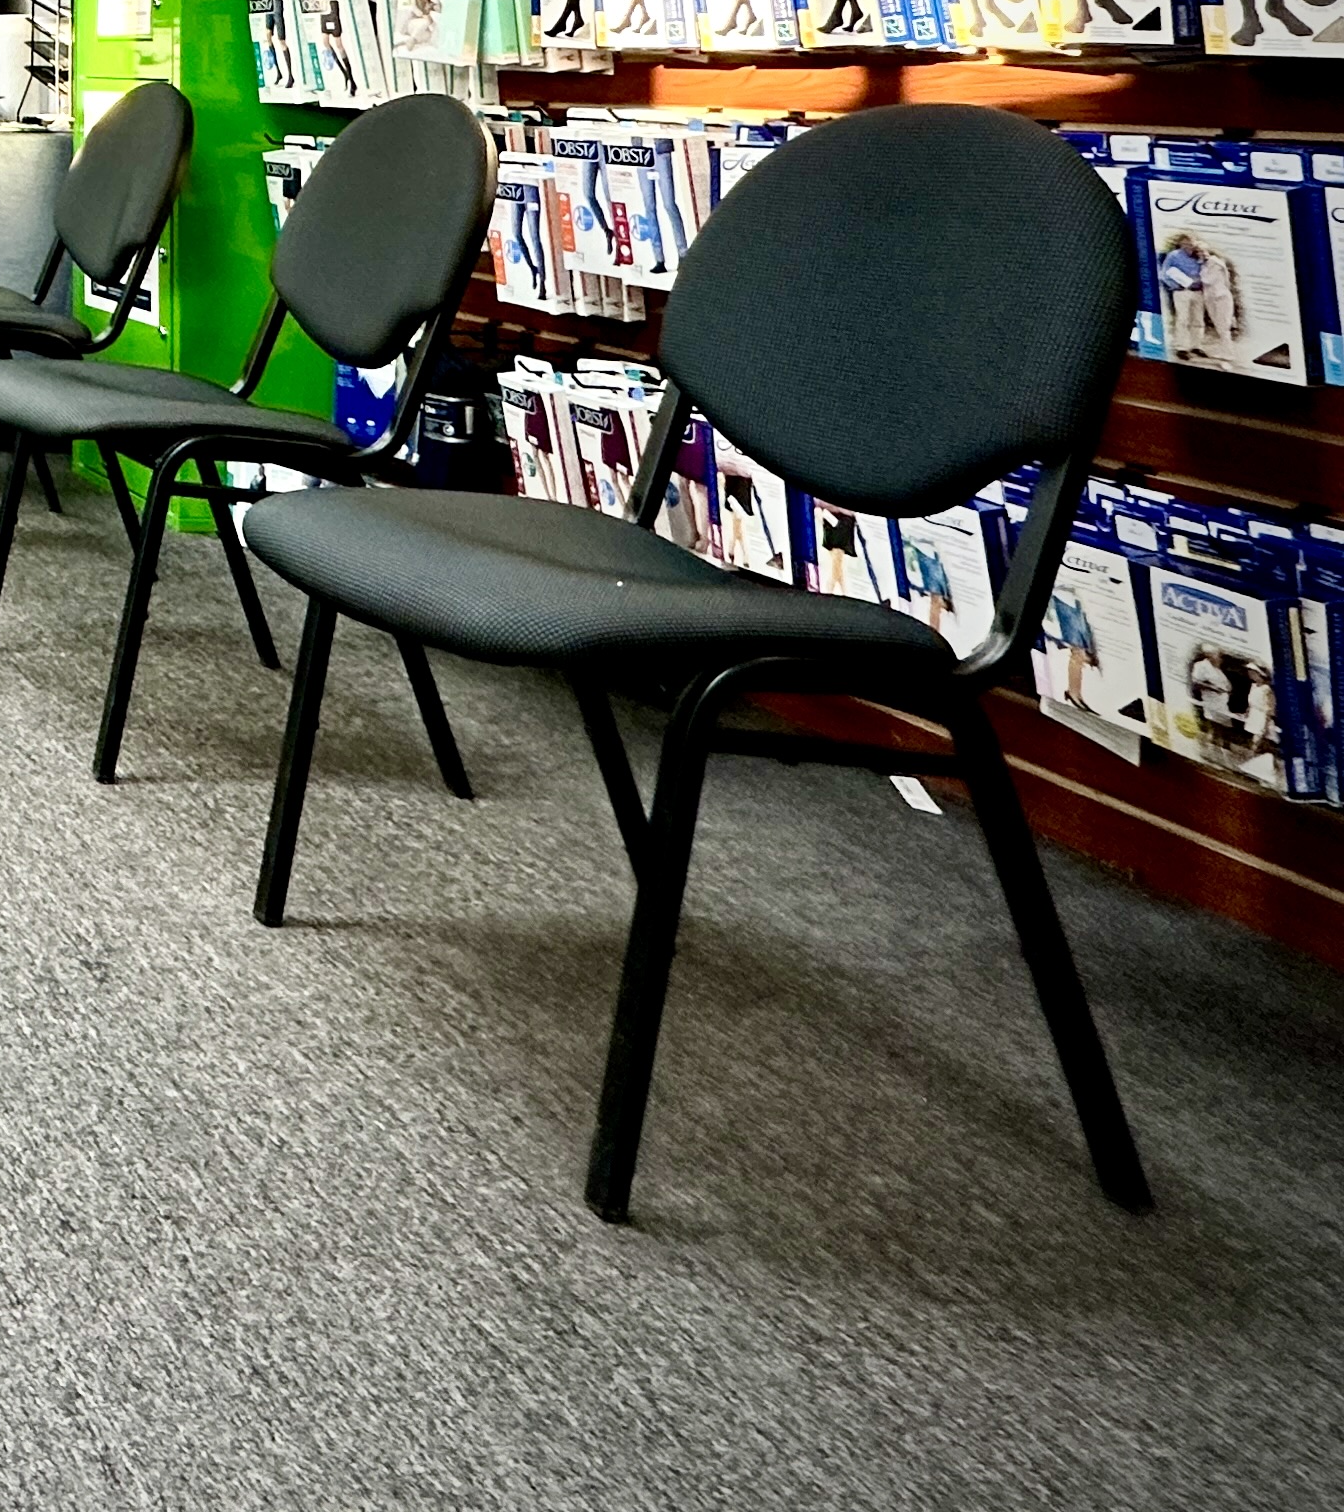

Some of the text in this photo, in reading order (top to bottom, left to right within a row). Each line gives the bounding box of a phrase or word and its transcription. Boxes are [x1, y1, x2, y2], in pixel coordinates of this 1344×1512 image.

[250, 0, 274, 13] JOBST
[555, 140, 597, 159] JOBST
[607, 148, 651, 166] JOBST
[267, 164, 292, 178] JOBST
[1155, 192, 1278, 223] Activa
[505, 390, 534, 409] JOBST
[574, 406, 609, 426] JOBST
[1164, 586, 1246, 630] ACTIVA
